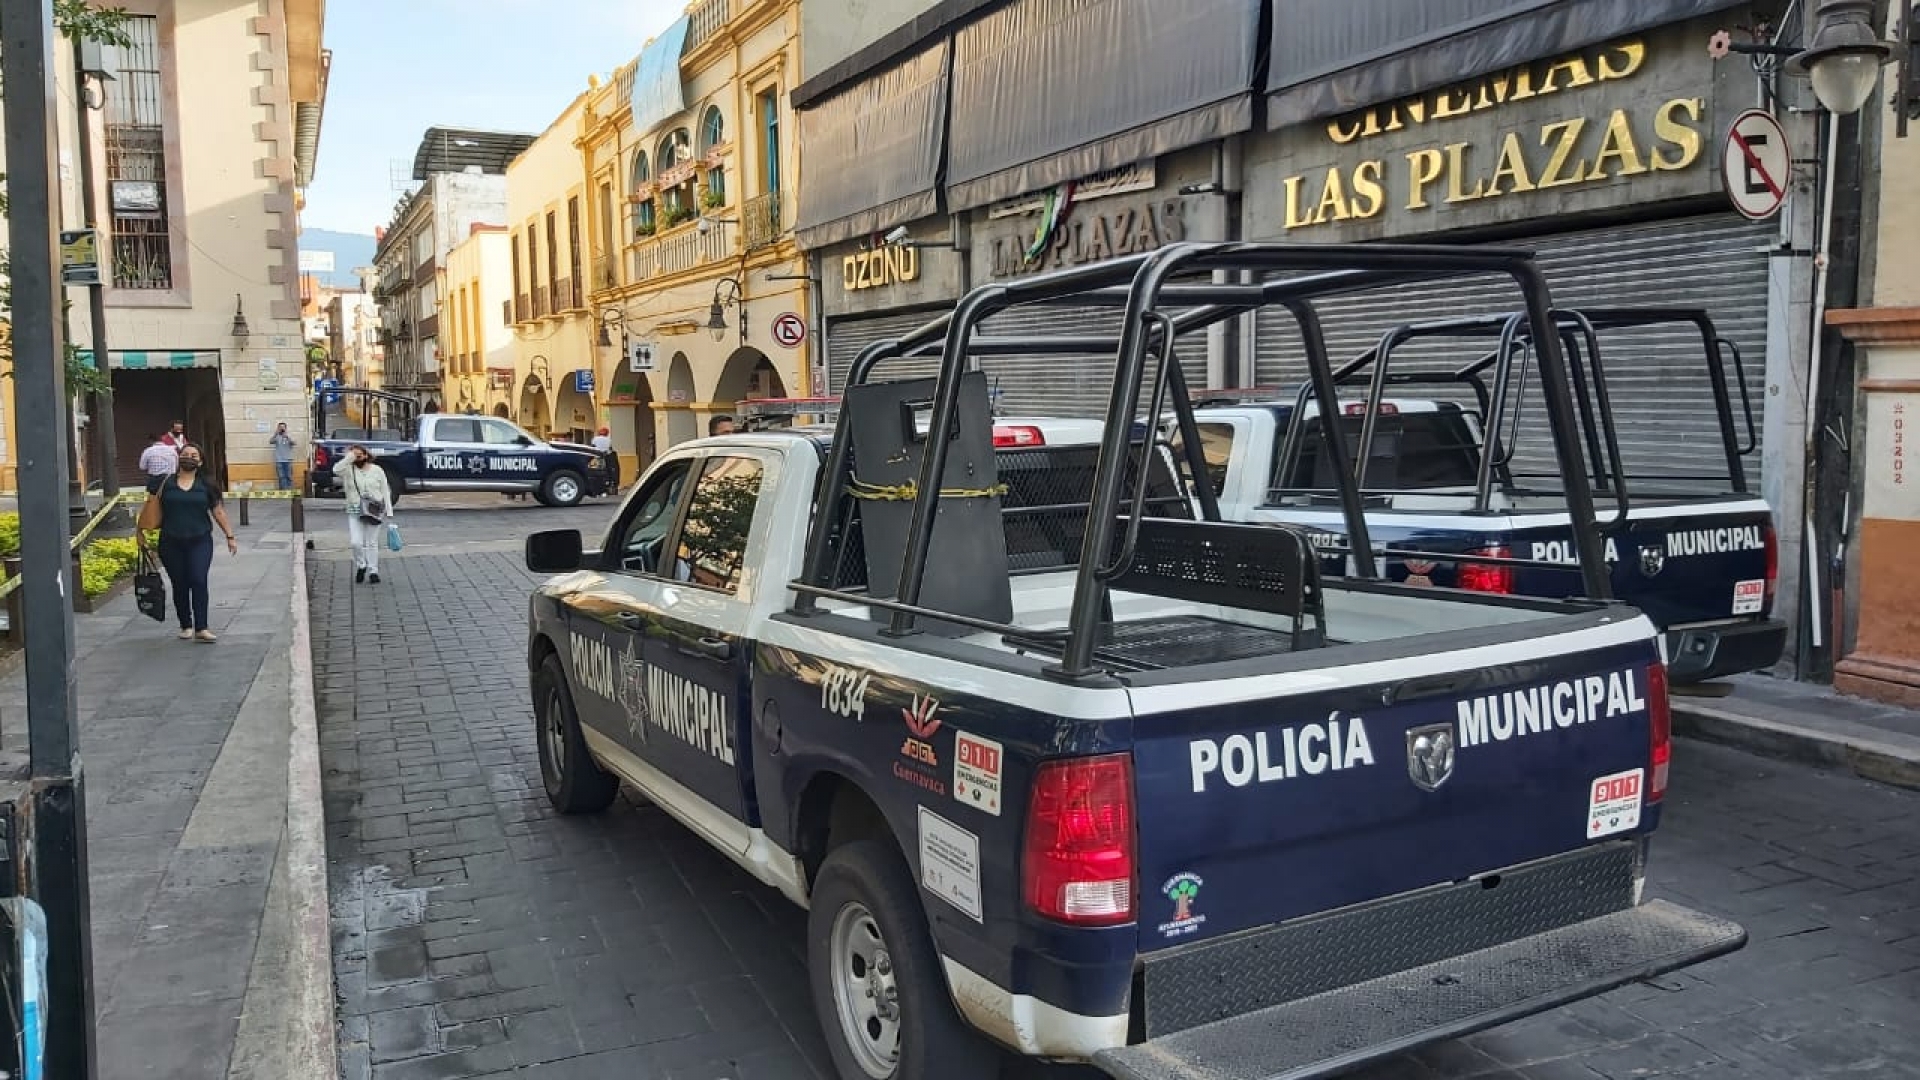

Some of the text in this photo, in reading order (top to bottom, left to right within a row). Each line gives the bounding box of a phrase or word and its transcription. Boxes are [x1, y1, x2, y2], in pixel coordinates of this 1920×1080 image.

[1283, 97, 1706, 229] LAS PLAZAS
[1053, 197, 1186, 267] PLAZAS
[843, 244, 919, 291] OZONO
[425, 455, 538, 471] POLICÍA MUNICIPAL
[1532, 525, 1765, 565] POLA MUNICIPAL
[570, 631, 735, 766] POLICÍA MUNICIPAL
[820, 667, 871, 721] 1834
[1190, 669, 1645, 793] POLICÍA MUNICIPAL
[893, 761, 946, 796] Cuernavaca
[960, 739, 1000, 774] 911
[1596, 776, 1638, 803] 911
